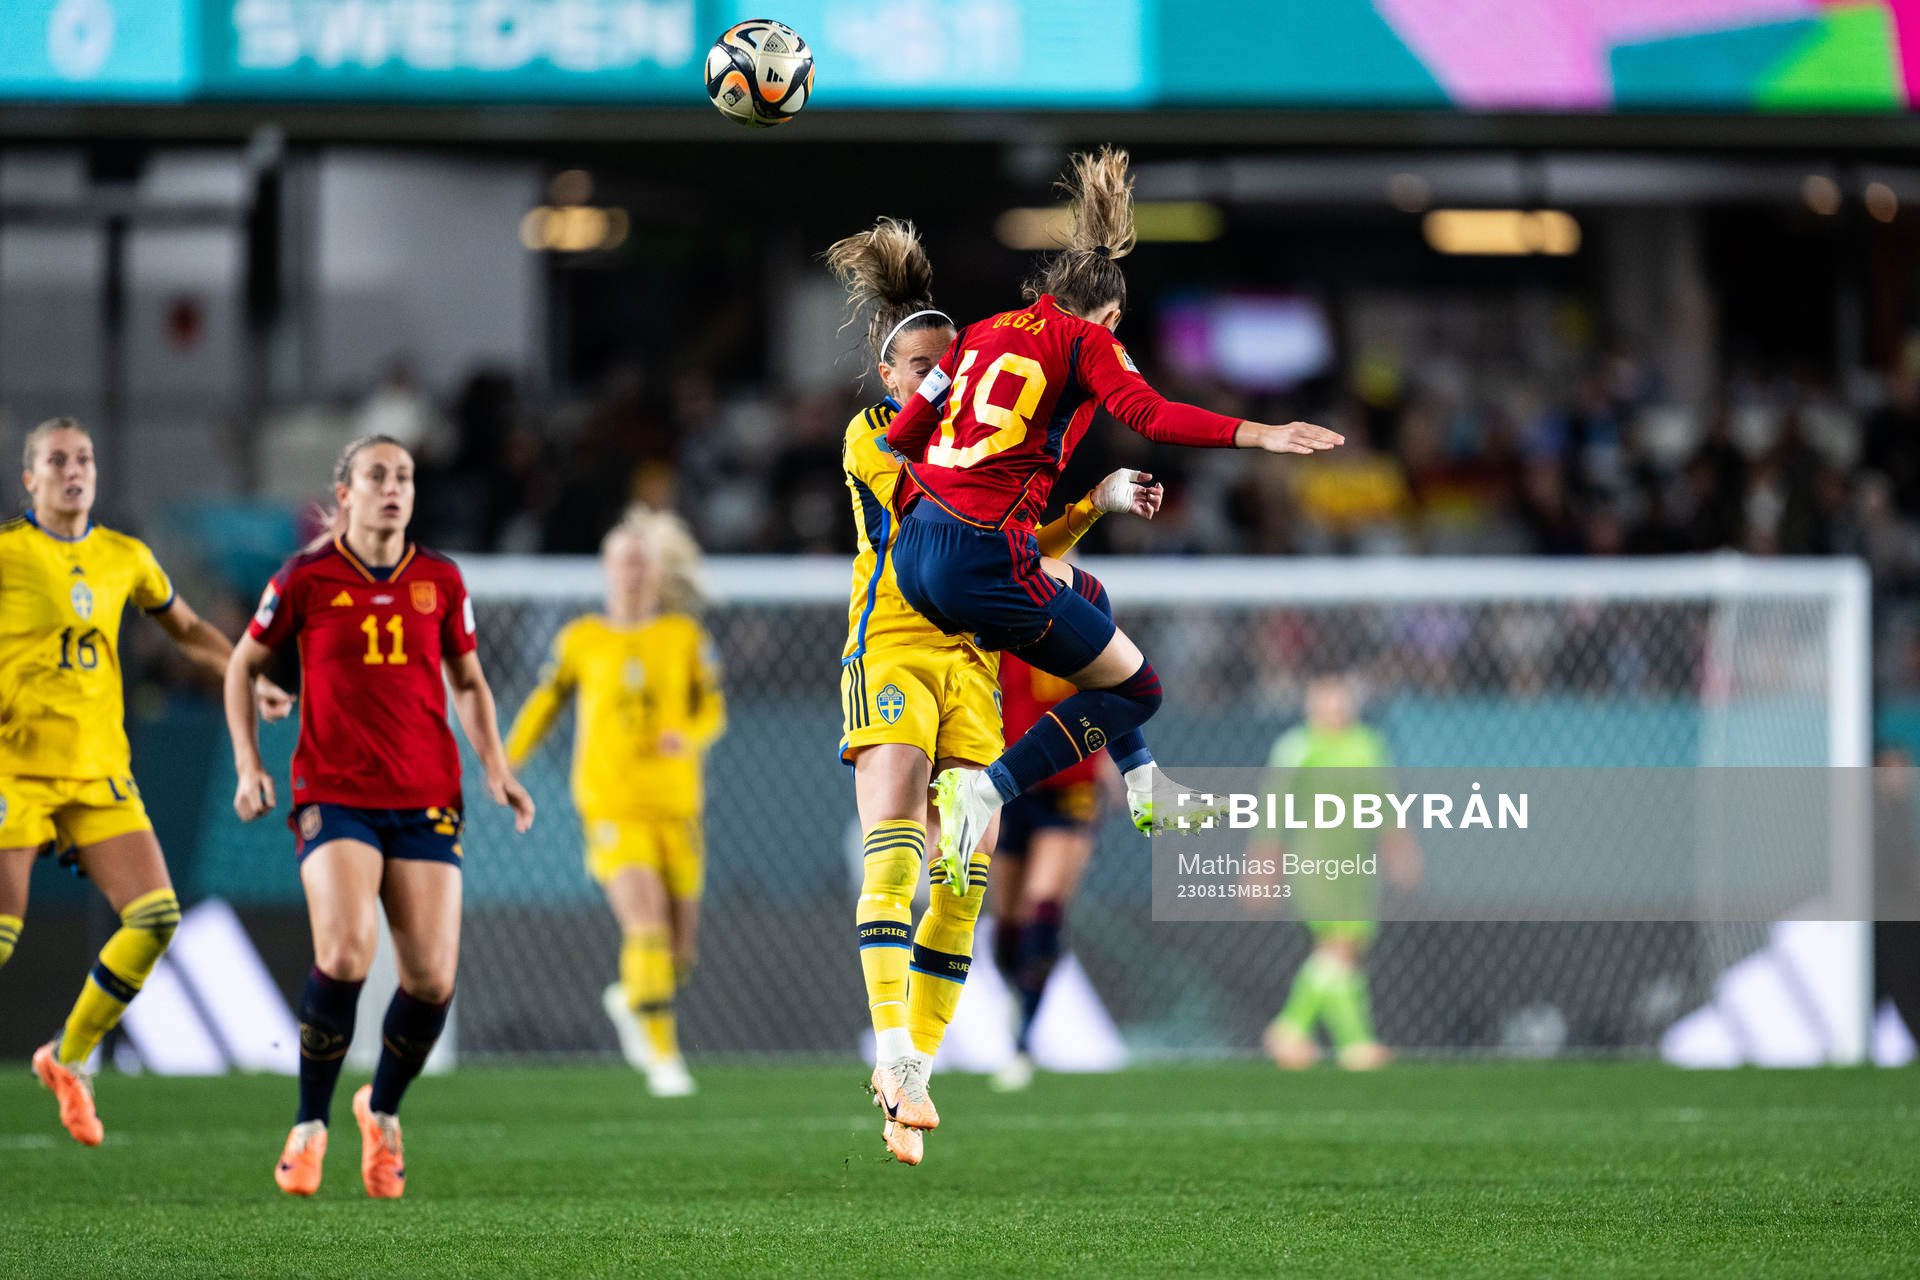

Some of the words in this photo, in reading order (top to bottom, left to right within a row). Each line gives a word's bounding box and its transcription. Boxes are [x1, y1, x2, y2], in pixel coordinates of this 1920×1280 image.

[232, 0, 695, 70] SWEDEN
[992, 312, 1046, 335] OLGA
[927, 349, 1047, 469] 19
[58, 626, 98, 669] 16
[360, 614, 408, 665] 11
